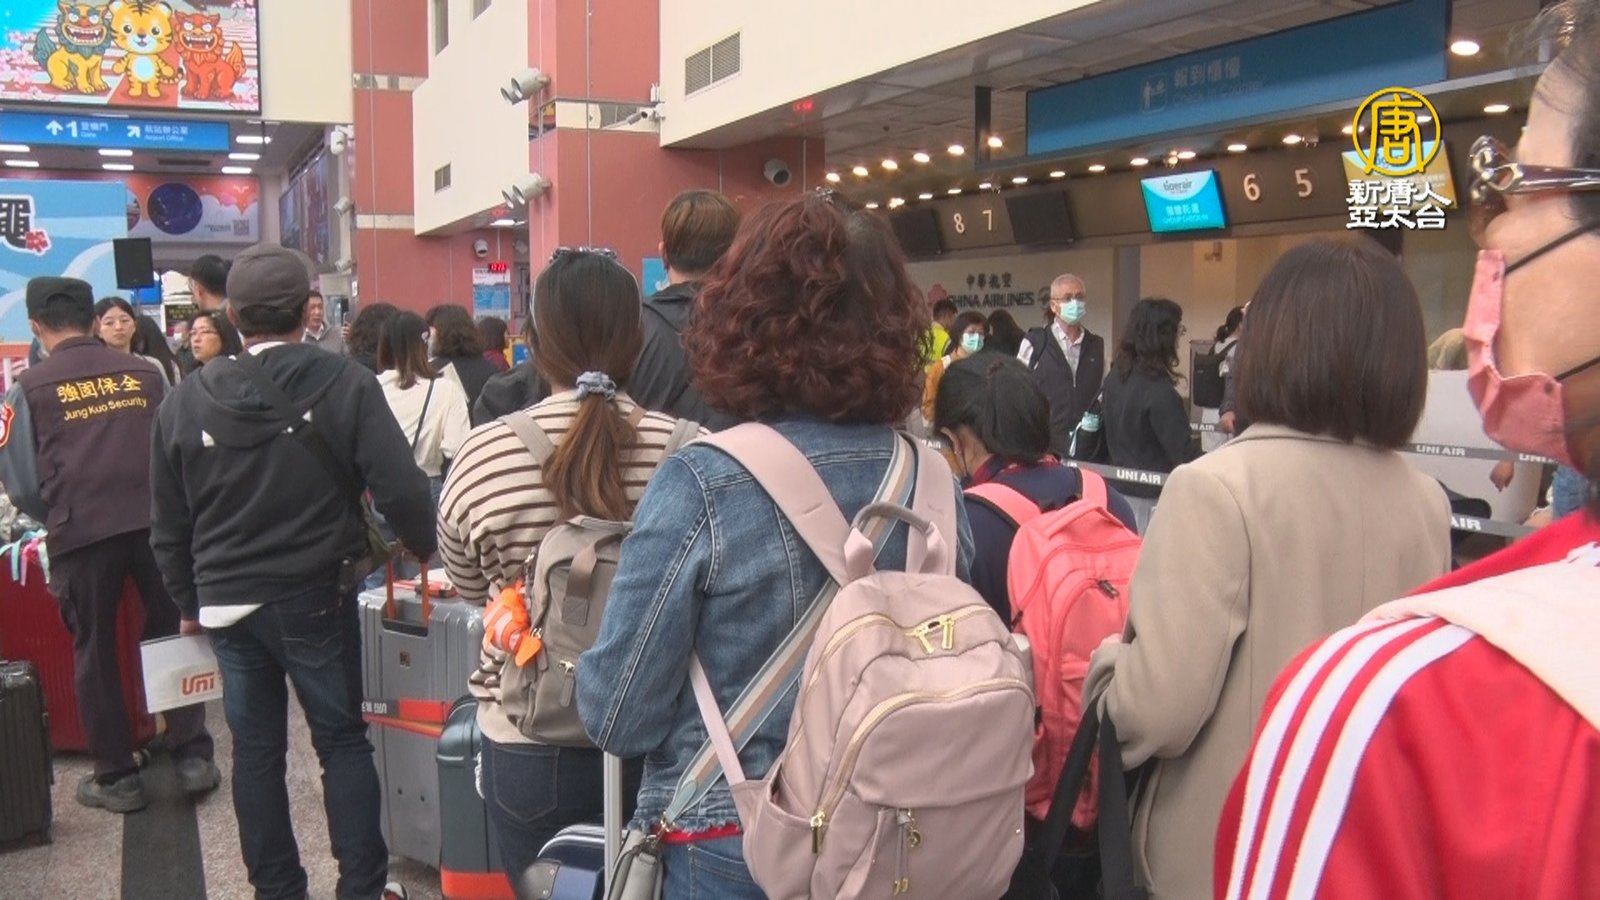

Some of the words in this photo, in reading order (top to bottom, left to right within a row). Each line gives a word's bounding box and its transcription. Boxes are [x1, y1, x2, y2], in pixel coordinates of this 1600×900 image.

[1243, 174, 1261, 201] 6
[1295, 168, 1312, 197] 5
[953, 212, 966, 234] 8
[982, 209, 993, 231] 7
[982, 292, 1034, 307] AIRLINES
[64, 408, 89, 421] Jung
[88, 404, 108, 415] Kuo
[107, 396, 147, 409] Security
[1416, 444, 1440, 454] UNI
[1442, 447, 1466, 456] AIR
[1116, 469, 1138, 481] UNI
[1140, 472, 1161, 485] AIR
[1451, 516, 1481, 531] AIR
